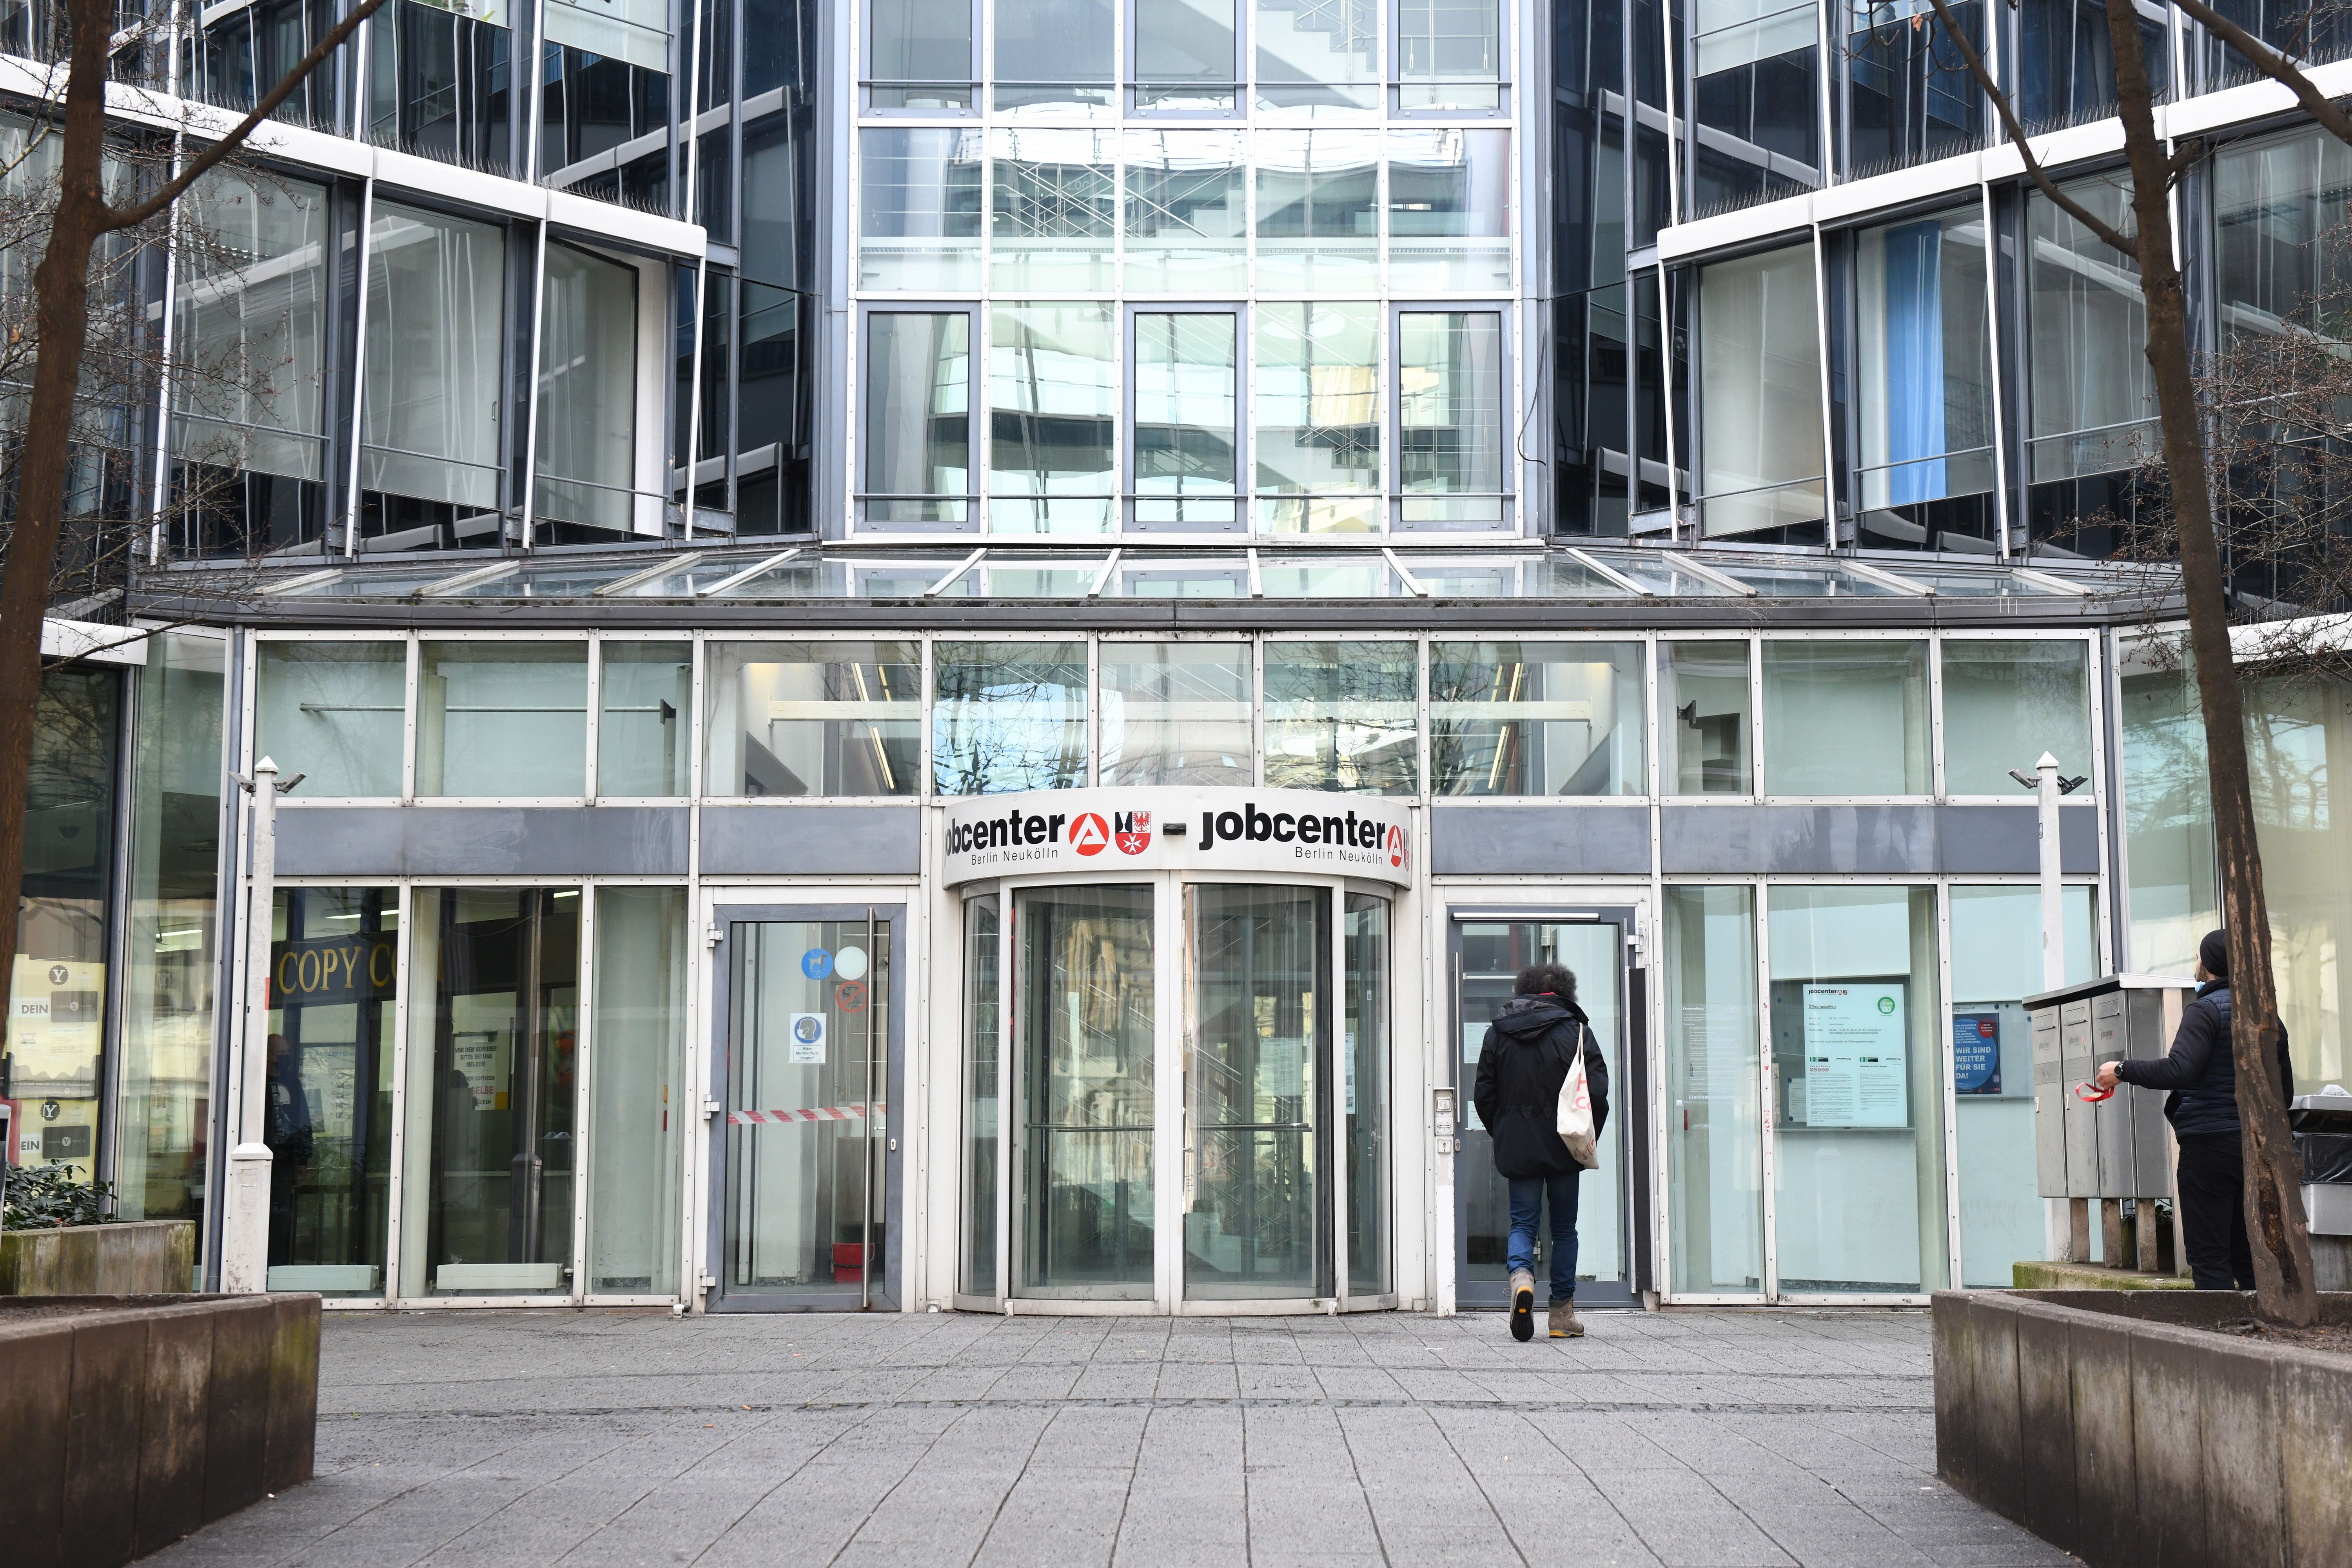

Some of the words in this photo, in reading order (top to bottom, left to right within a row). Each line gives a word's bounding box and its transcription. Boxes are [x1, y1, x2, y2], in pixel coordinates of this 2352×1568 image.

[945, 809, 1065, 858] obcenter
[1199, 803, 1385, 850] jobcenter
[972, 852, 998, 865] Berlin
[1003, 847, 1058, 862] Neukölln
[1295, 846, 1333, 860] Berlin
[1339, 849, 1383, 865] Neukölln
[278, 946, 363, 995] COPY
[22, 1004, 48, 1014] DEIN
[20, 1141, 40, 1151] EIN
